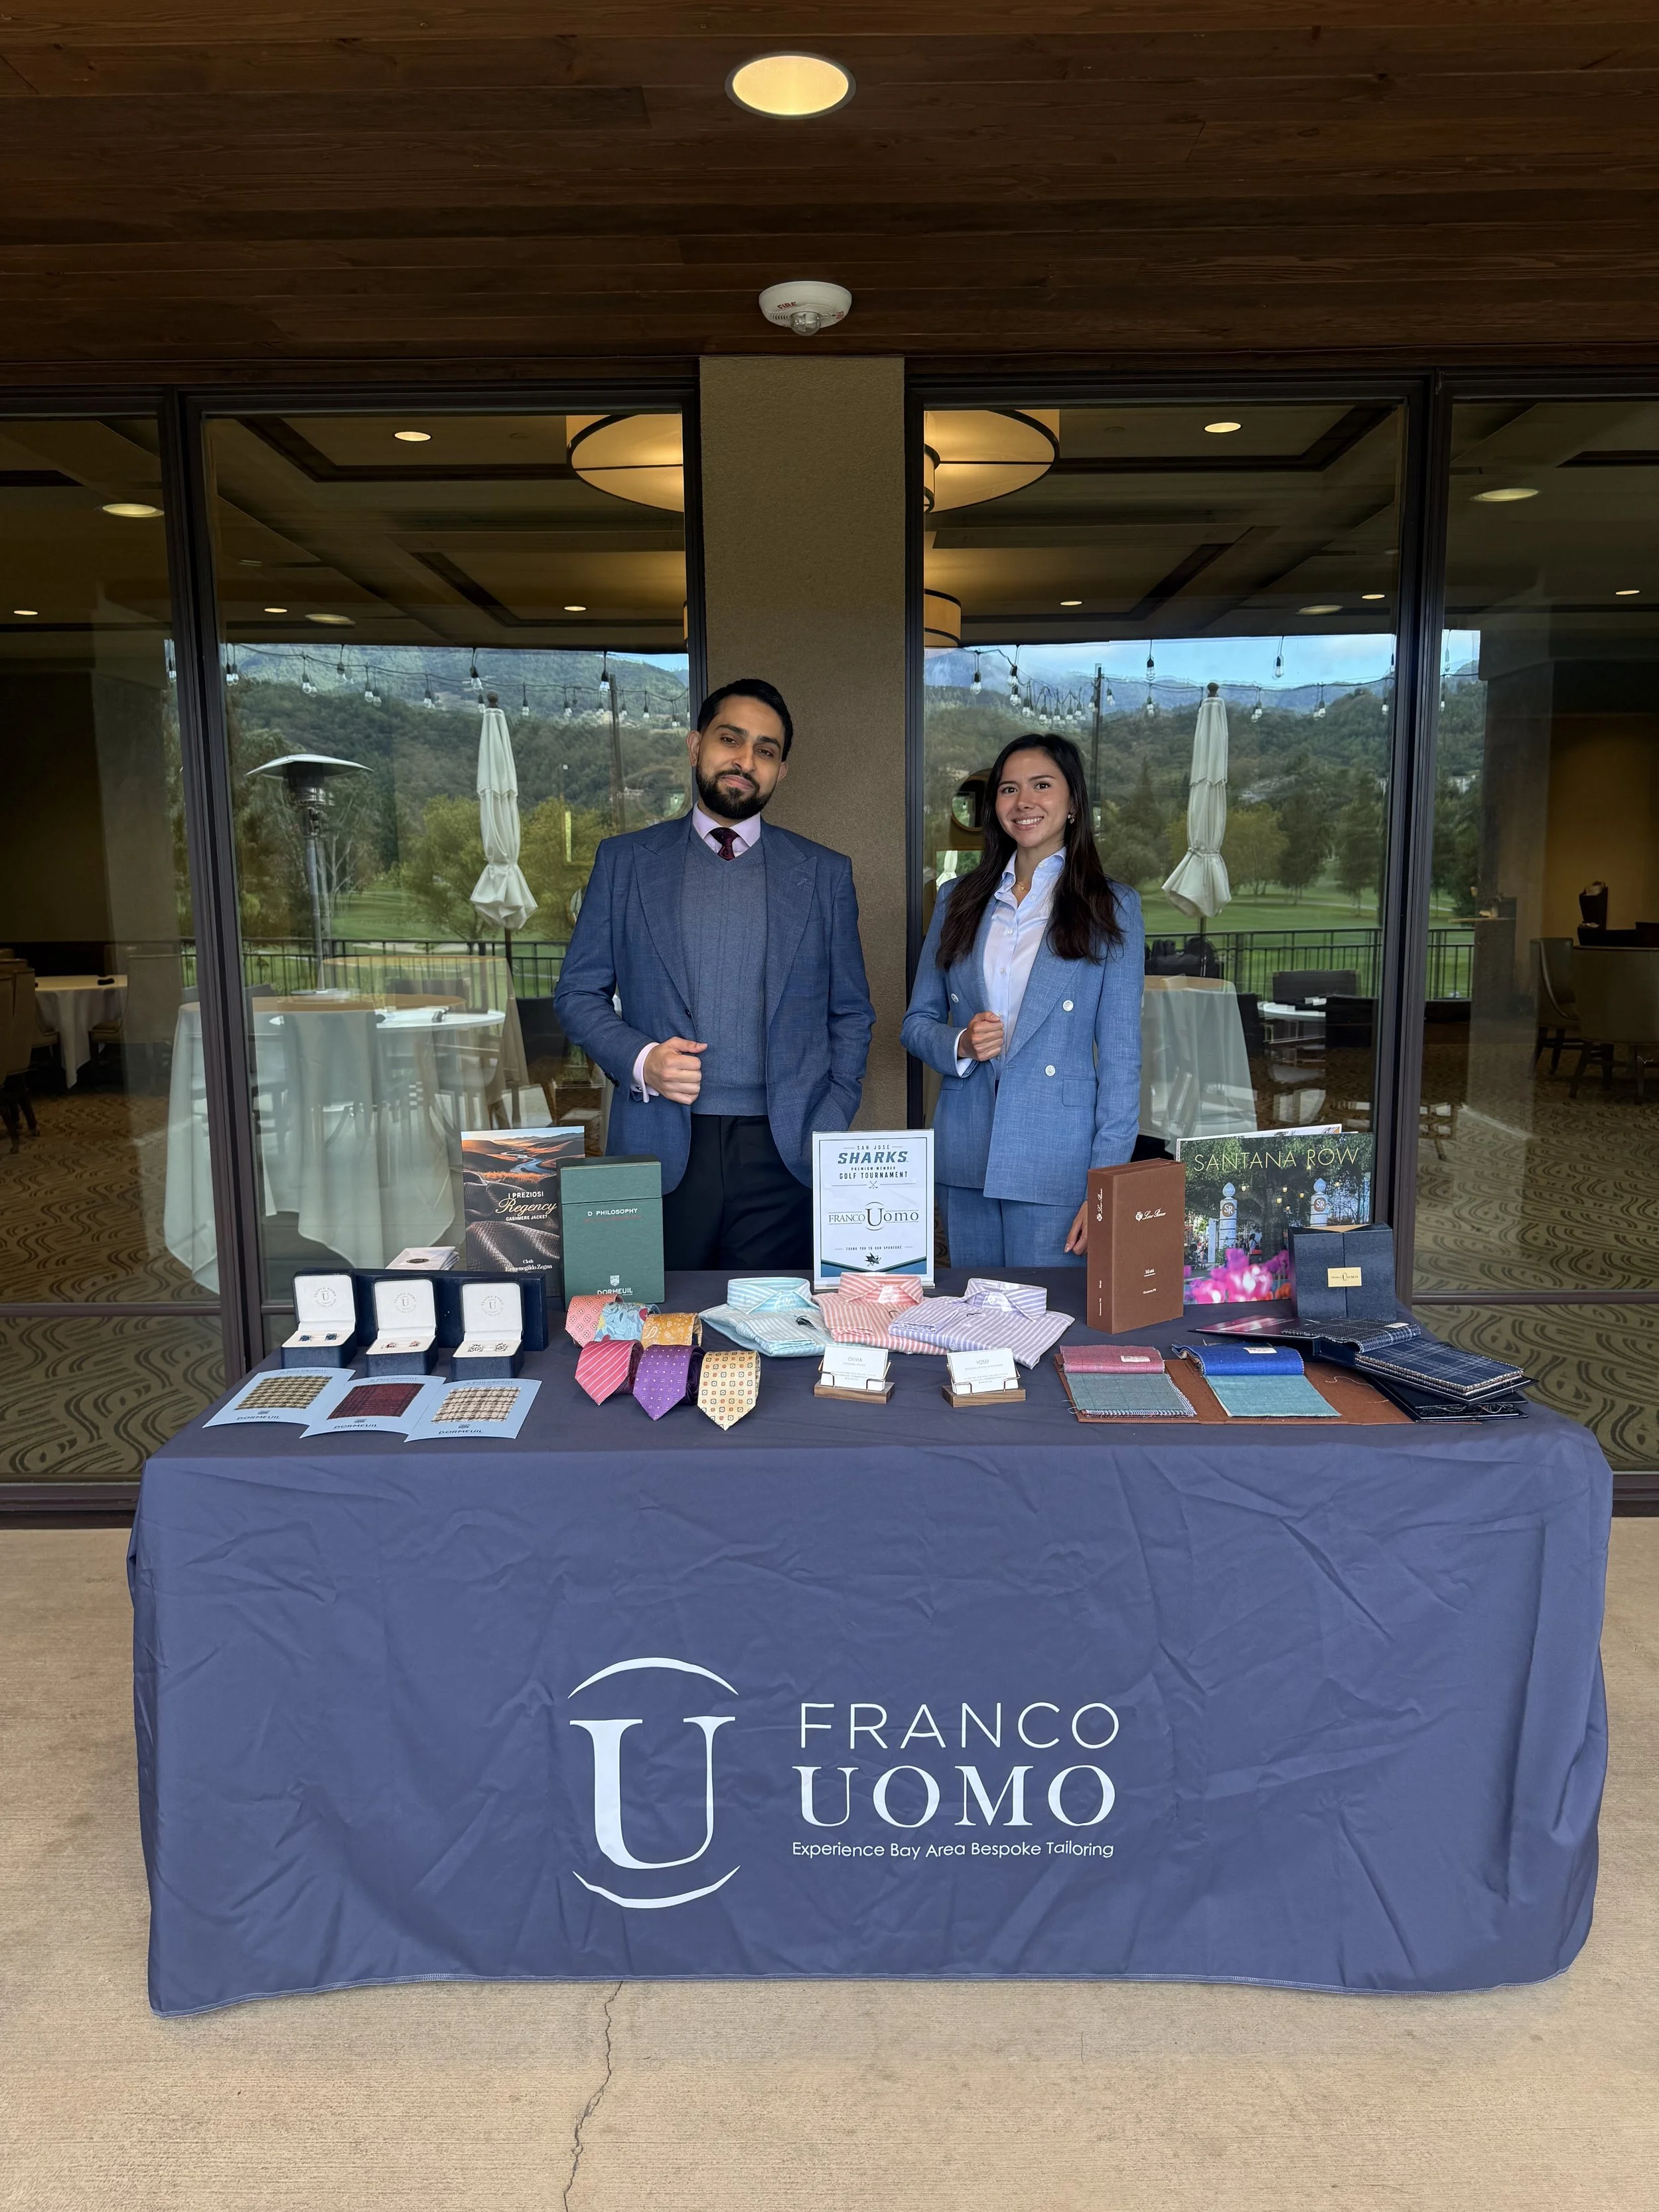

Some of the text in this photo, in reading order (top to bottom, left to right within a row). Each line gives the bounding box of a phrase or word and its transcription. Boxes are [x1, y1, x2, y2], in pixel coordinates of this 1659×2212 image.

[837, 1151, 908, 1164] SHARKS
[1193, 1146, 1358, 1172] SANTANA ROW
[495, 1198, 557, 1217] Regency
[1224, 1205, 1233, 1215] SR
[1315, 1201, 1325, 1209] SR
[828, 1214, 865, 1222] FRANCO
[800, 1702, 1119, 1749] FRANCO
[569, 1716, 736, 1870] U
[792, 1764, 1116, 1828] UOMO
[792, 1840, 1114, 1860] Experience Bay Area Bespoke Tailoring
